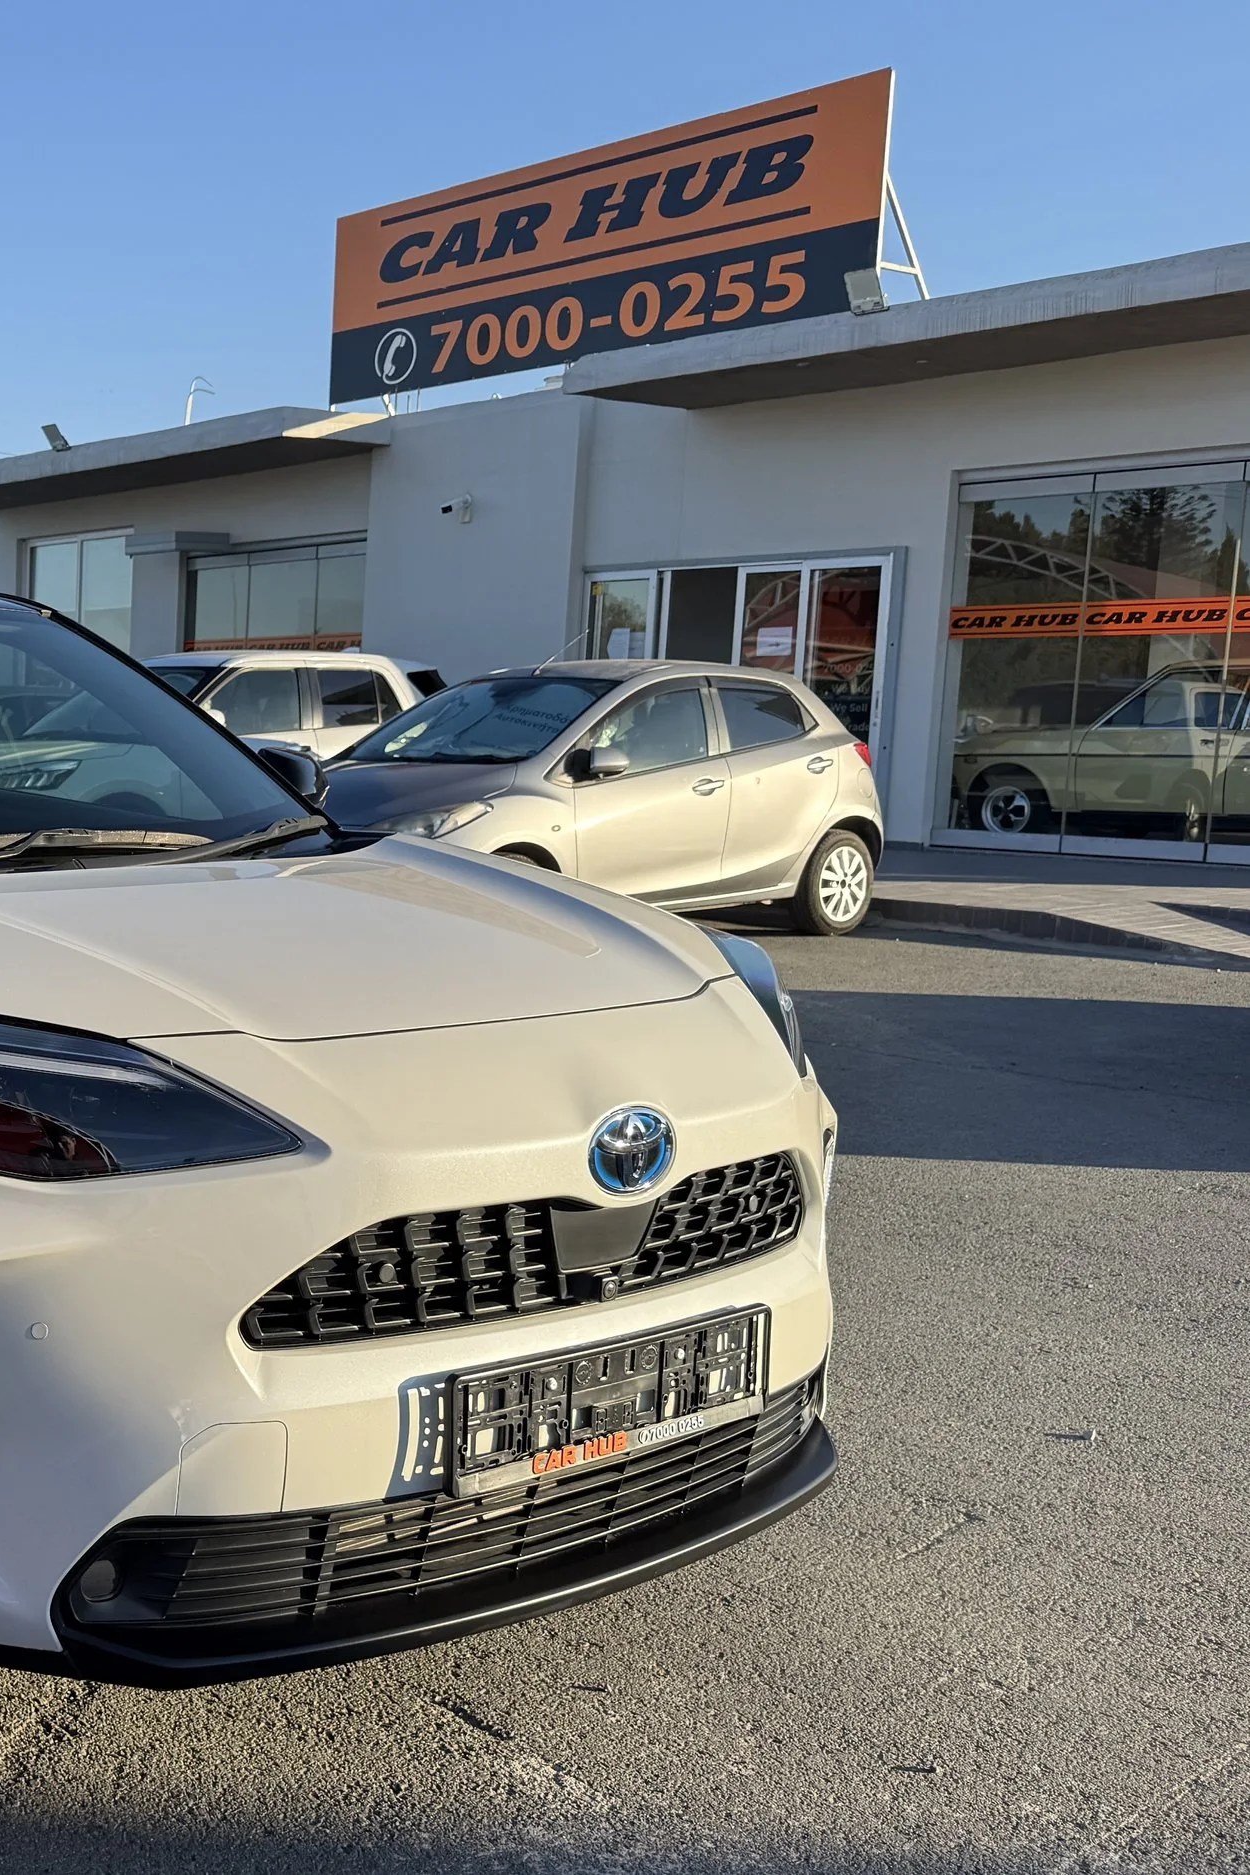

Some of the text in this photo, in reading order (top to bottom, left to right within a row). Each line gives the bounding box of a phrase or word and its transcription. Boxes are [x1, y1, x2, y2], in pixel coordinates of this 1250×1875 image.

[379, 133, 814, 283] CAR HUB
[430, 249, 807, 374] 7000-0255
[951, 613, 1079, 629] CAR HUB
[1085, 611, 1146, 625] CAR
[1151, 608, 1228, 623] HUB
[316, 640, 345, 651] CAR
[849, 702, 868, 713] Sell
[532, 1414, 704, 1474] CAR HUB 7000 0255
